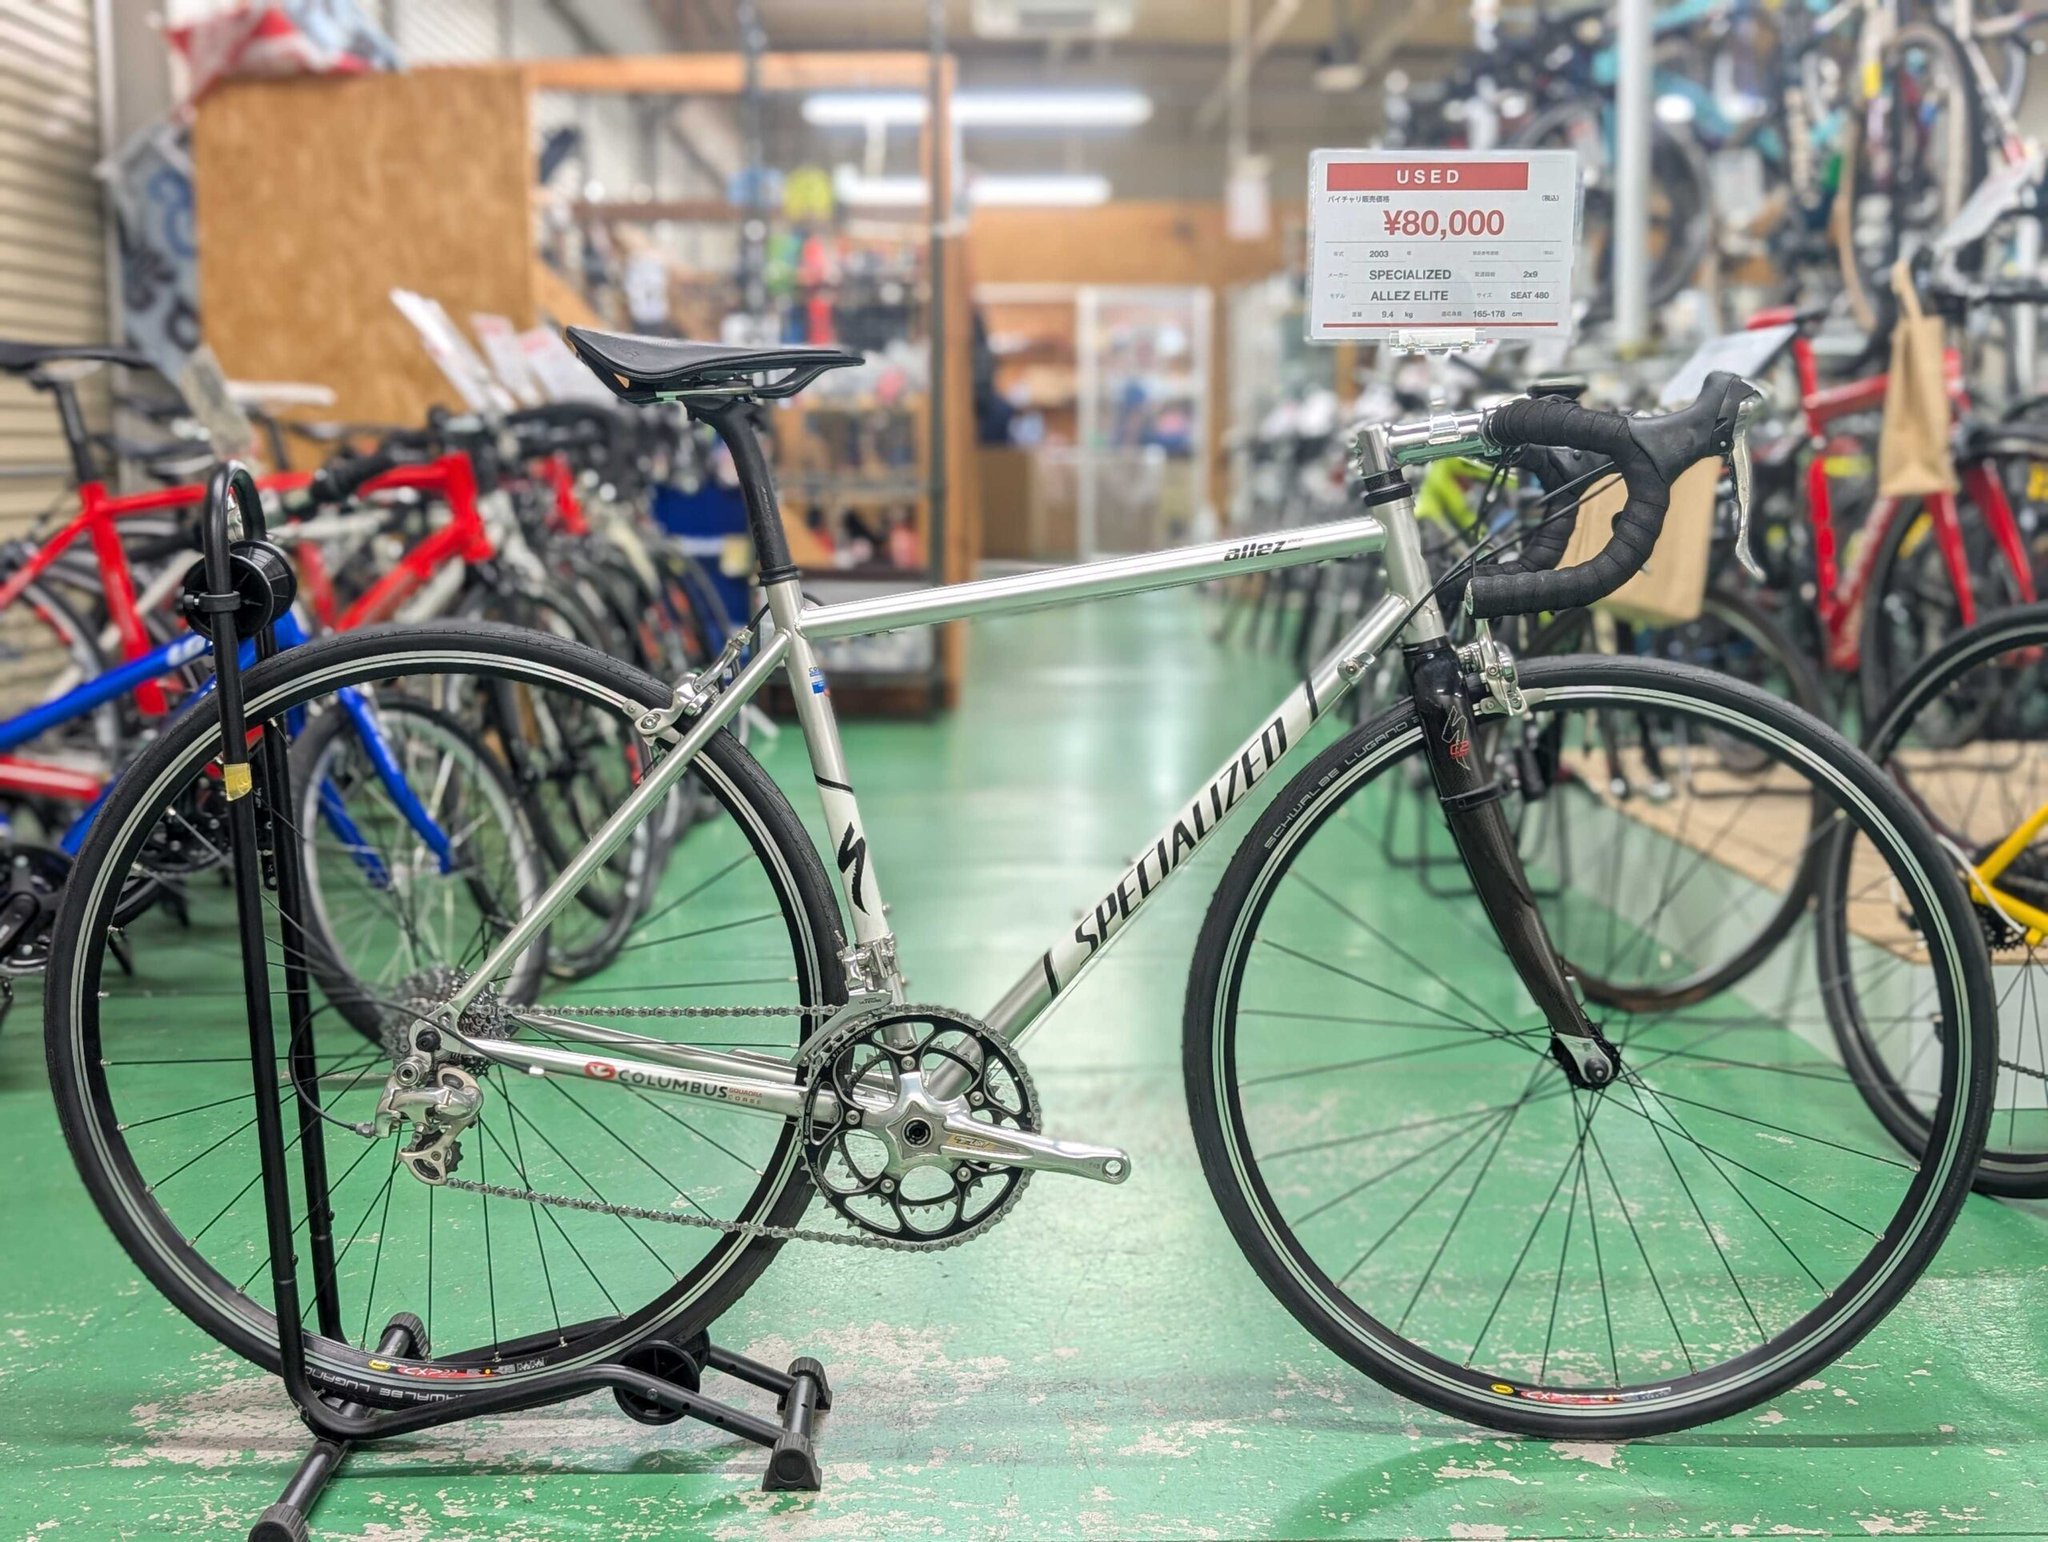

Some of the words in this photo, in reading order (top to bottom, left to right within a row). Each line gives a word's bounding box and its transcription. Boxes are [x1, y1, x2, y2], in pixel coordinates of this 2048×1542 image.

[1396, 170, 1460, 184] USED
[1327, 195, 1390, 204] バイチャリ販売価格
[1383, 209, 1505, 241] ¥80,000
[1369, 250, 1389, 258] 2003
[1368, 269, 1452, 280] SPECIALIZED
[1370, 291, 1411, 301] ALLEZ
[1413, 290, 1449, 301] ELITE
[1534, 291, 1550, 299] 480
[1404, 311, 1414, 319] kg
[1472, 310, 1506, 318] 165-178
[1264, 767, 1340, 849] SCHWALBE
[1344, 721, 1408, 766] LUGANO
[1075, 716, 1288, 967] SPECIALIZED
[618, 1069, 728, 1099] COLUMBUS
